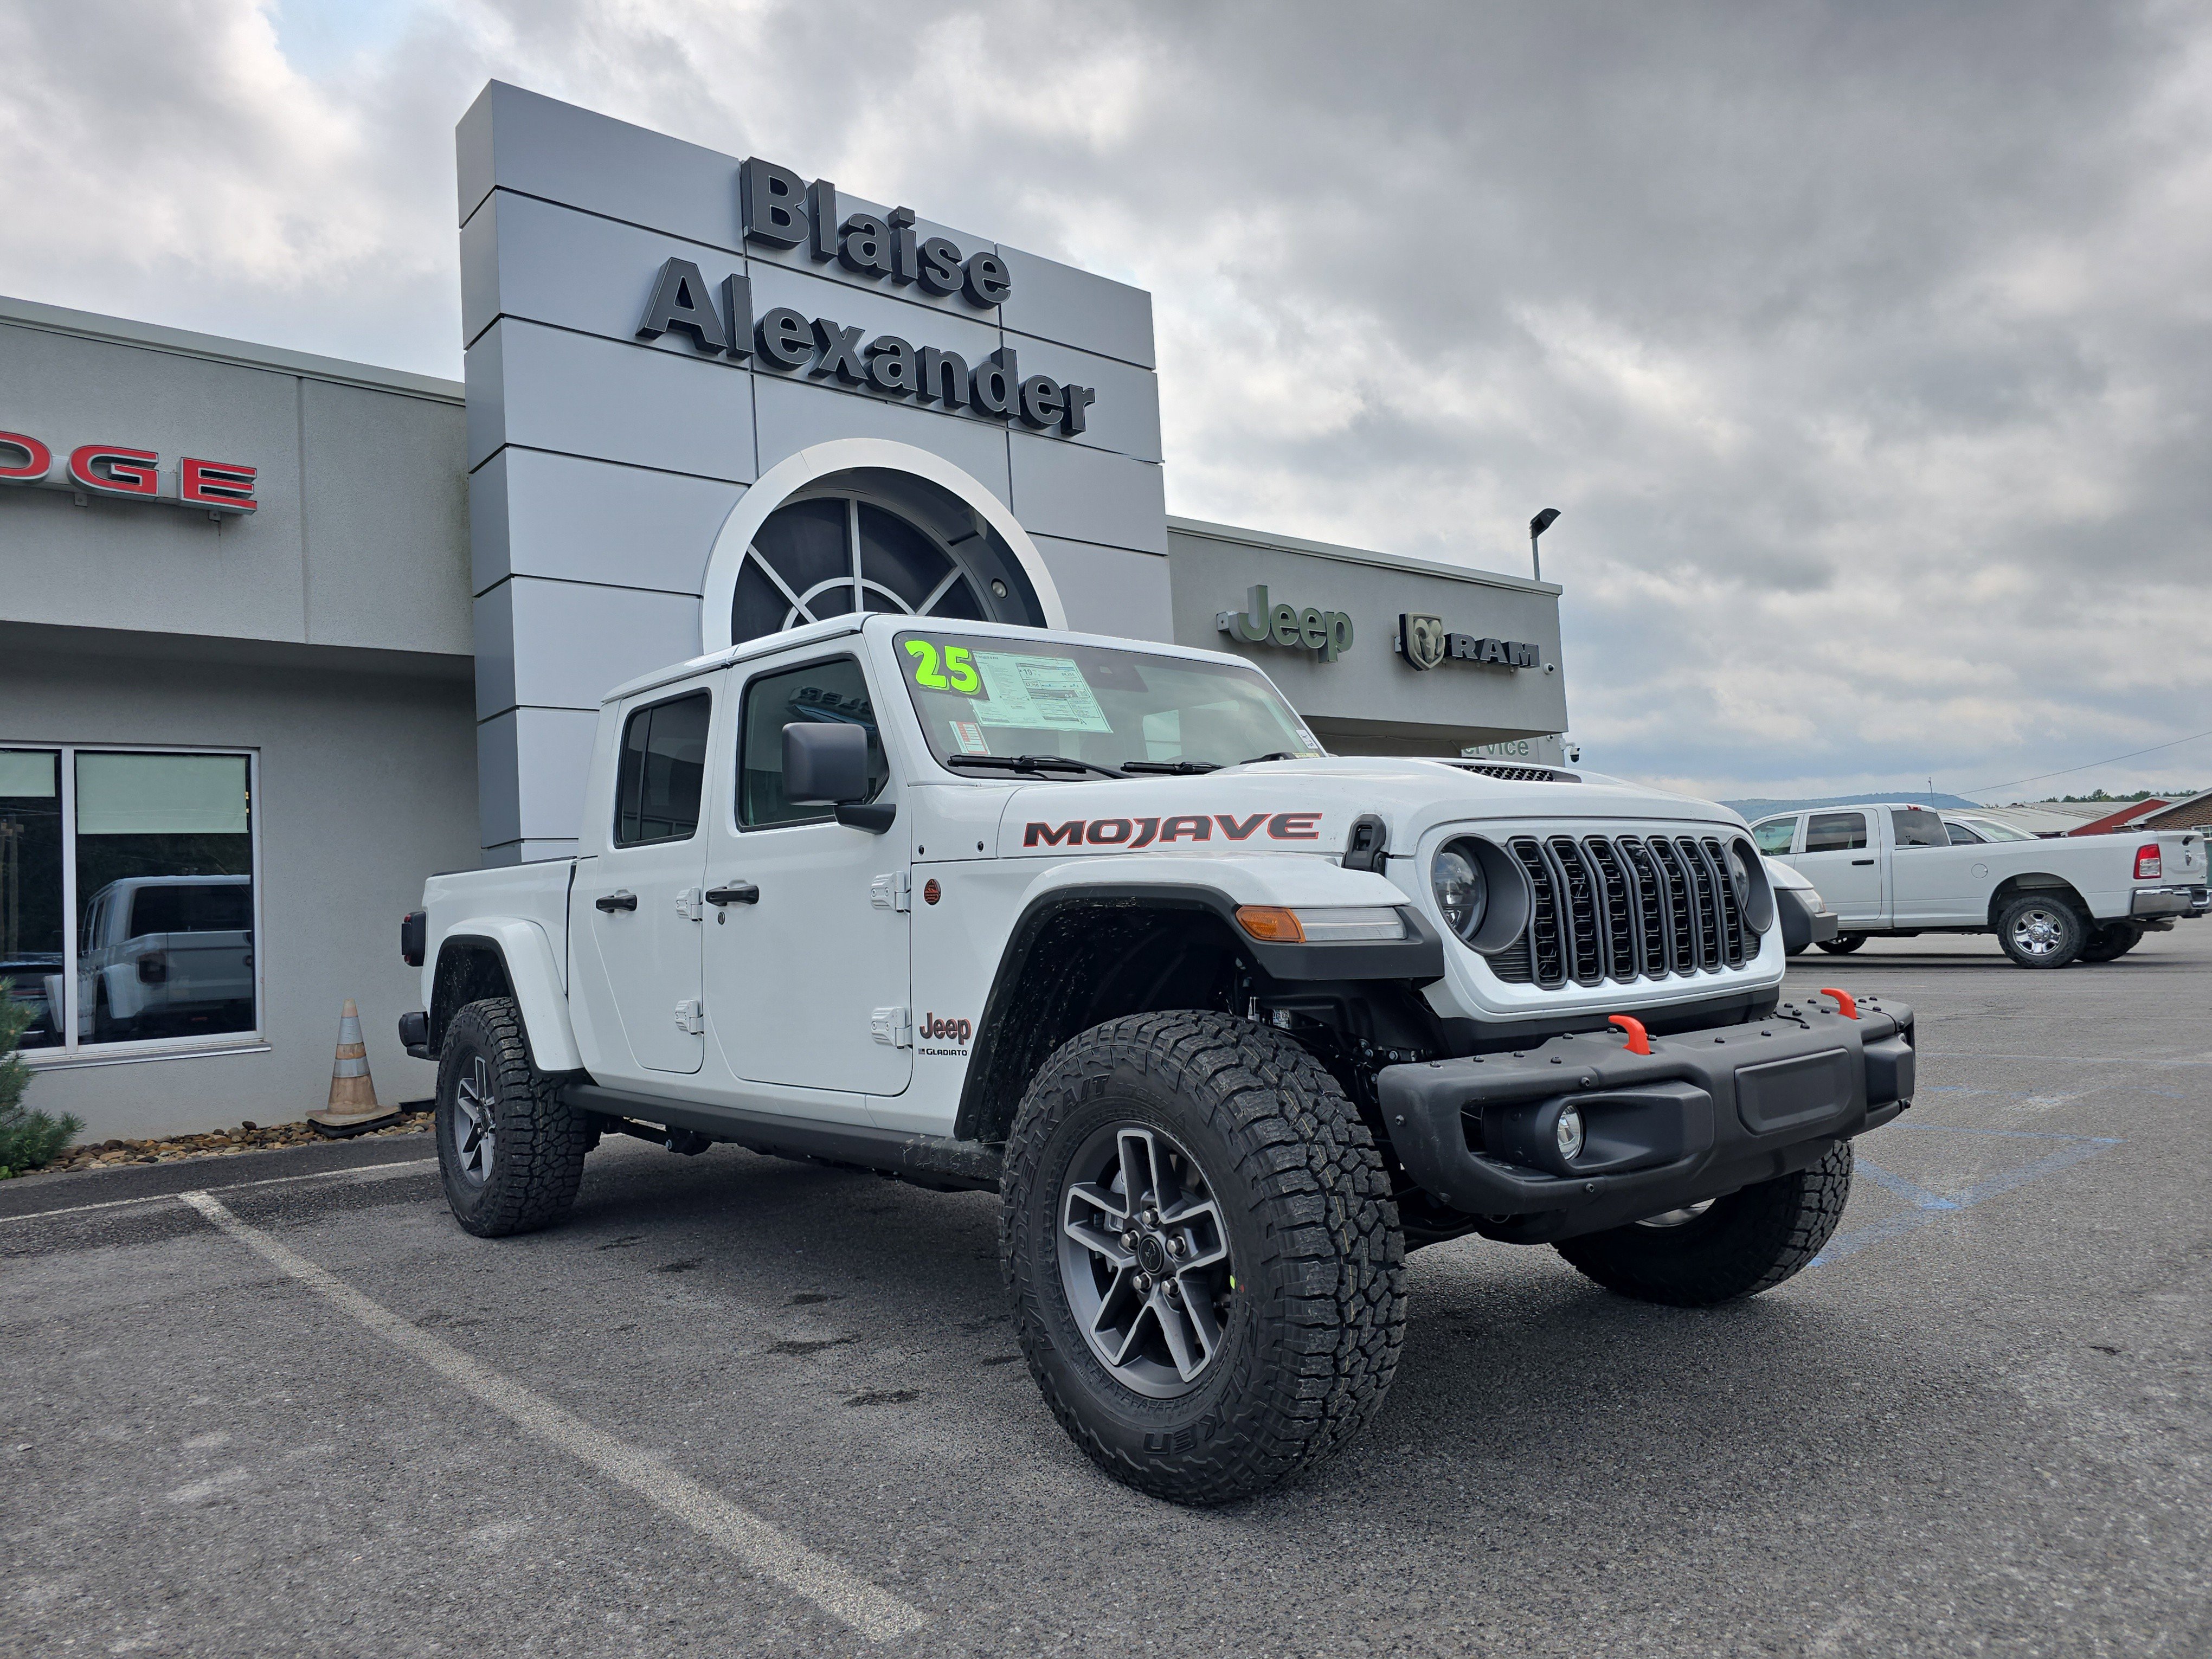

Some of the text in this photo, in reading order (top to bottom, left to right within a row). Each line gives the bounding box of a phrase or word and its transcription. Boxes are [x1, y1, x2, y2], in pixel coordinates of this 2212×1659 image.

[742, 156, 1011, 310] Blaise
[636, 258, 1095, 436] Alexander
[1229, 584, 1354, 663] Jeep
[905, 640, 980, 695] 25
[1444, 633, 1540, 668] RAM
[1023, 812, 1322, 849] MOJAVE
[919, 1012, 971, 1045] Jeep
[926, 1048, 968, 1056] GLADIATO
